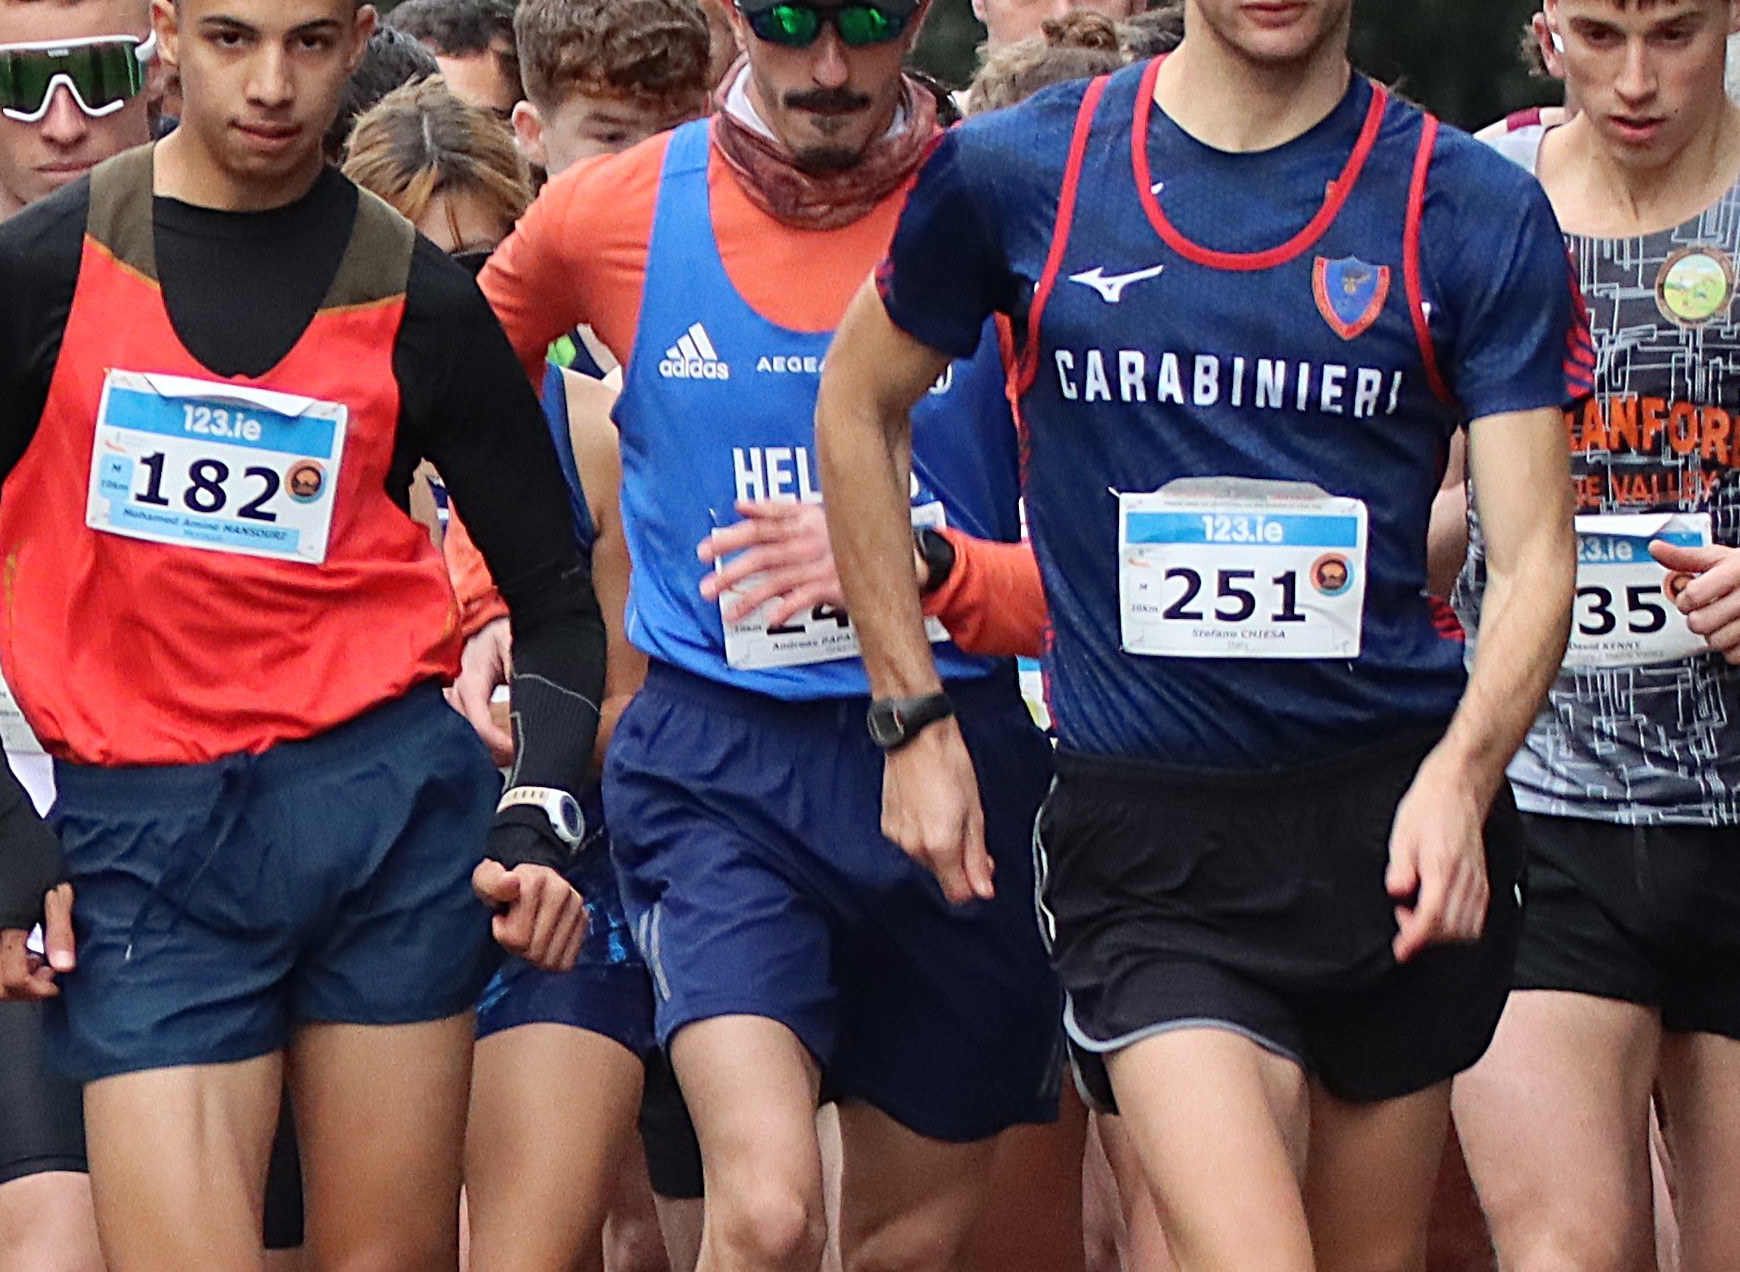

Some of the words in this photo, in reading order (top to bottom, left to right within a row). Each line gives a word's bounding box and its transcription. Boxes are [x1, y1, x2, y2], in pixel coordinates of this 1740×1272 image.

[658, 358, 730, 380] adidas
[1054, 349, 1405, 419] CARABINIERI
[182, 404, 263, 442] 123.ie
[134, 451, 281, 523] 182
[1201, 514, 1285, 543] 123.ie
[1576, 536, 1633, 562] 23.ie
[1162, 567, 1306, 623] 251
[1575, 584, 1667, 636] 35
